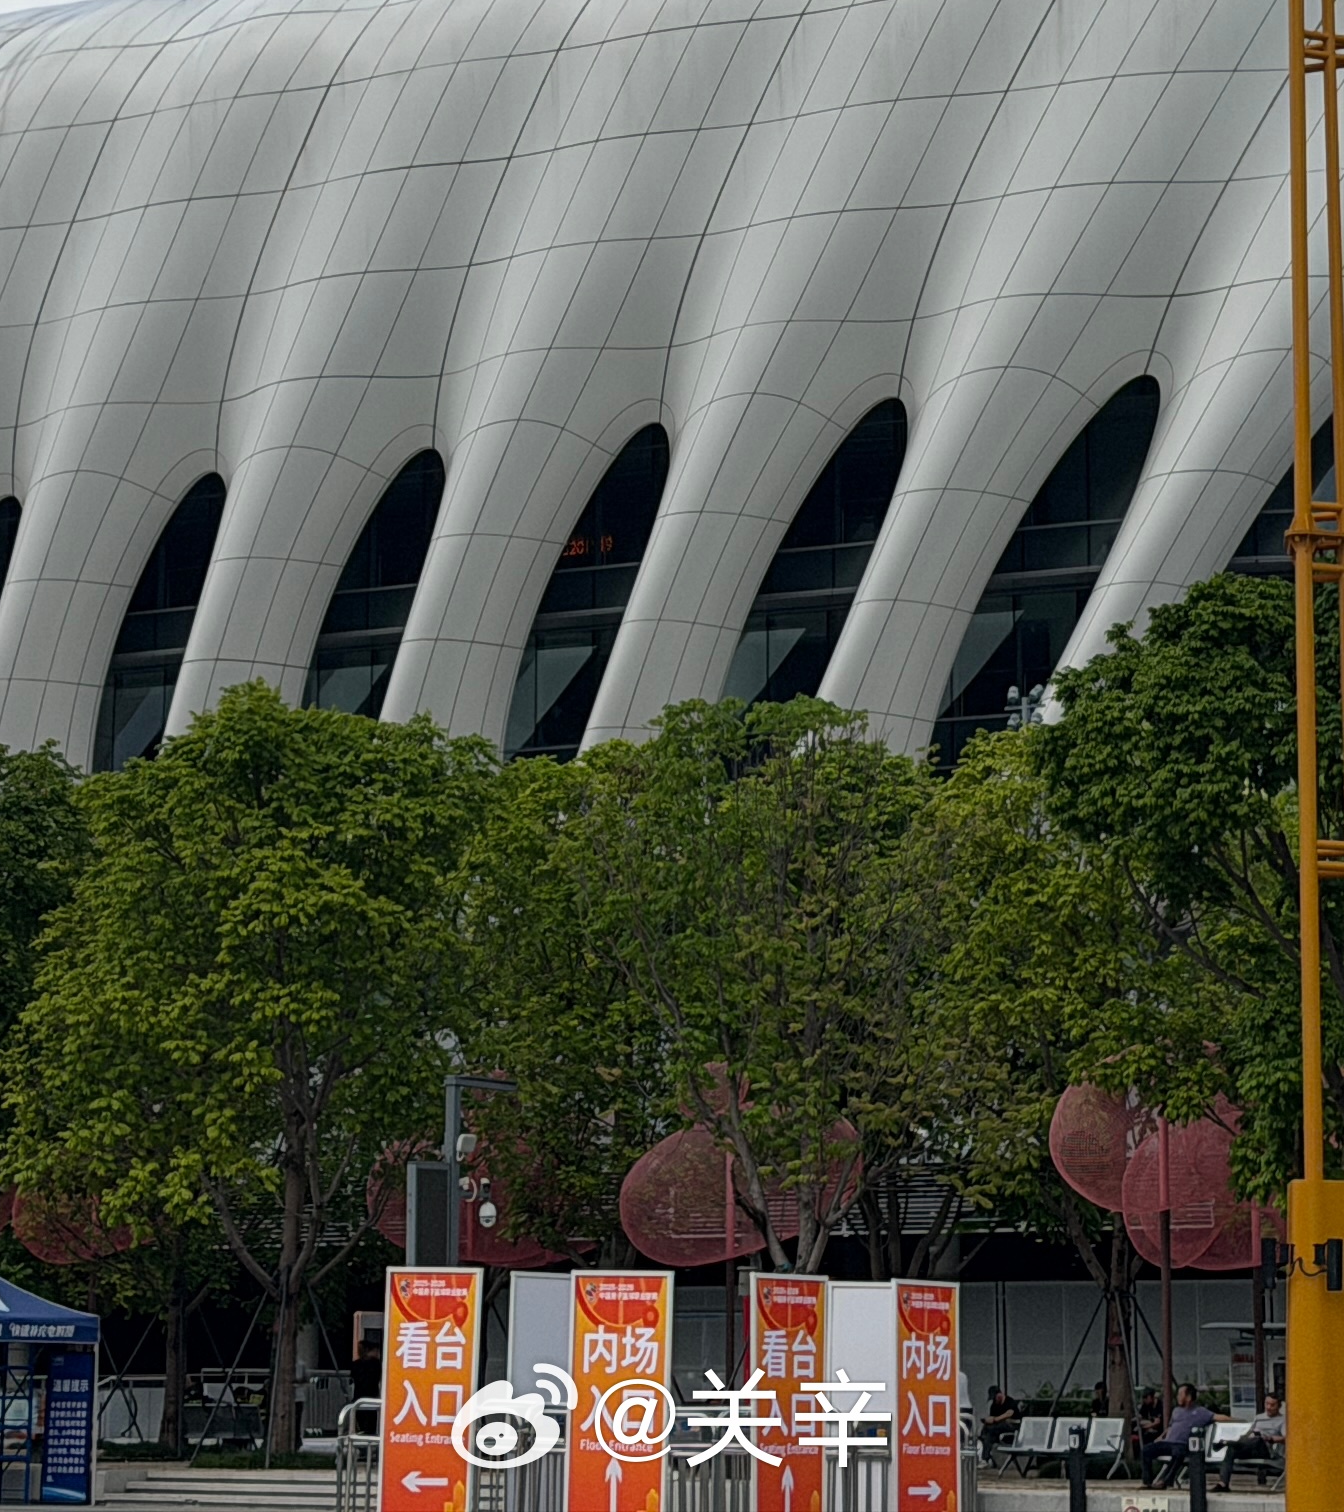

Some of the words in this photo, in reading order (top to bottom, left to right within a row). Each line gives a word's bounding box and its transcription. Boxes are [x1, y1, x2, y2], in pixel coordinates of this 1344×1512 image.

[395, 1320, 467, 1370] 看台
[582, 1324, 660, 1375] 内场
[761, 1329, 817, 1378] 看台
[902, 1331, 952, 1381] 内场
[393, 1379, 464, 1427] 入口
[902, 1390, 952, 1438] 入口
[389, 1430, 424, 1447] Seating
[425, 1431, 465, 1445] Entran
[579, 1438, 605, 1451] Floo
[902, 1442, 920, 1455] Floor
[920, 1443, 951, 1456] Entrance
